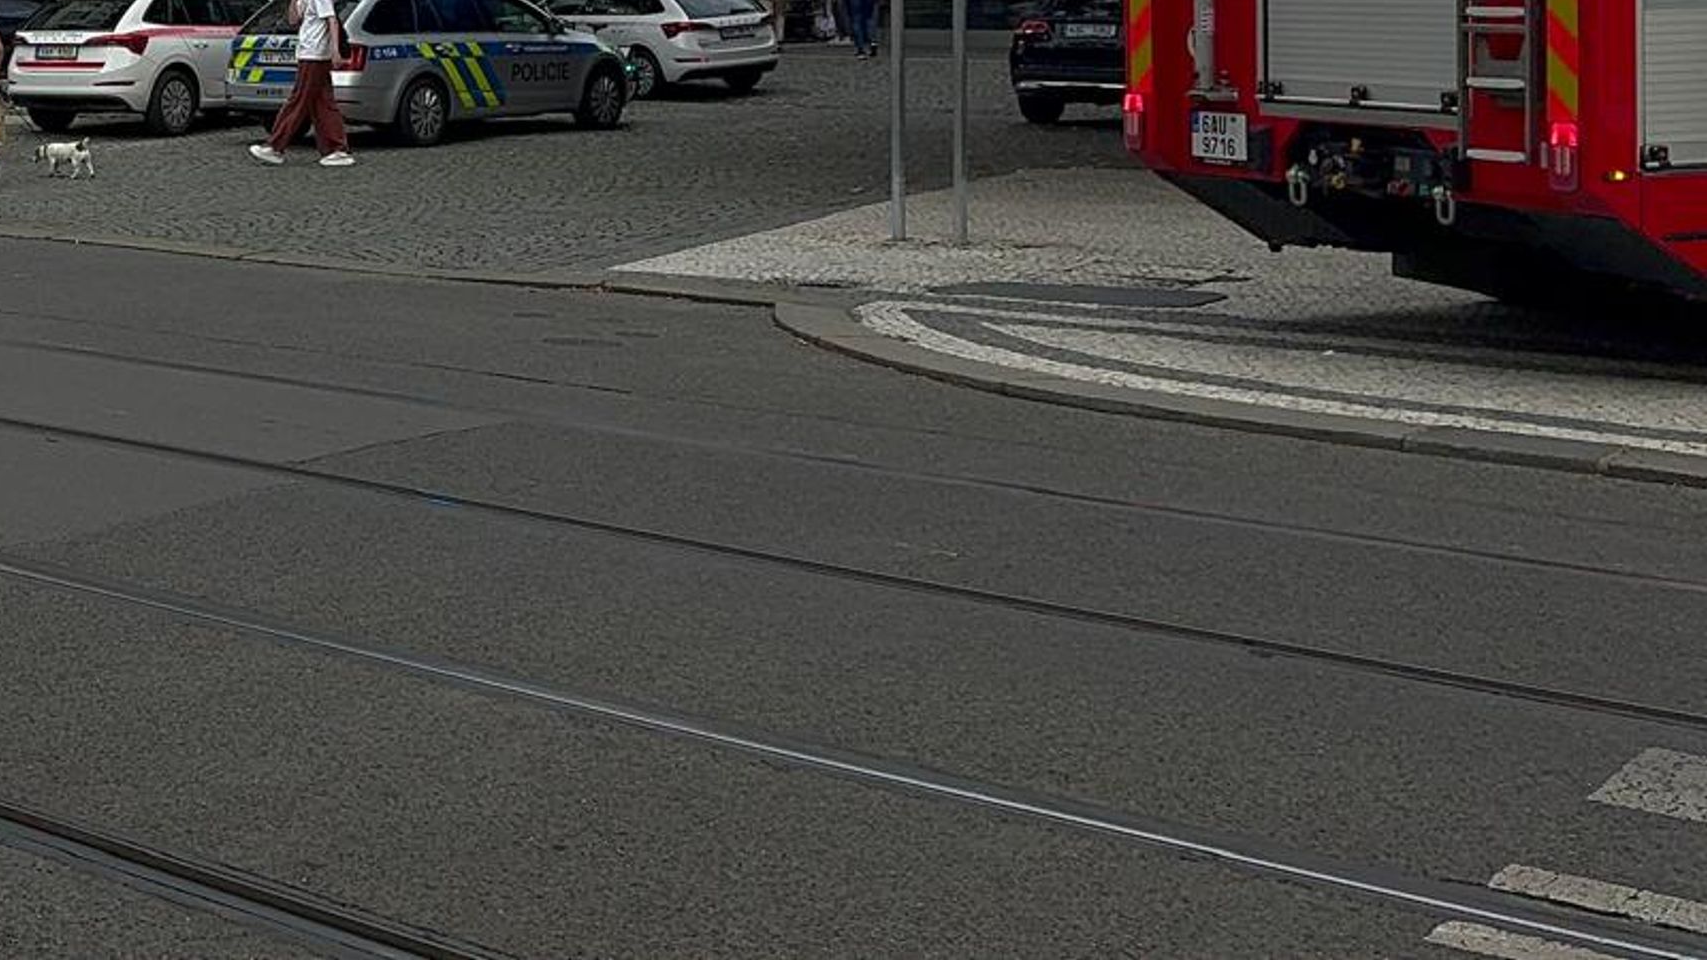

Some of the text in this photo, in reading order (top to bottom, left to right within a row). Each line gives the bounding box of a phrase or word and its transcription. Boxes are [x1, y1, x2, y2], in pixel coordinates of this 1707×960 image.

[511, 61, 571, 82] POLICIE
[1202, 114, 1227, 135] 6AU
[1202, 136, 1236, 157] 9716
